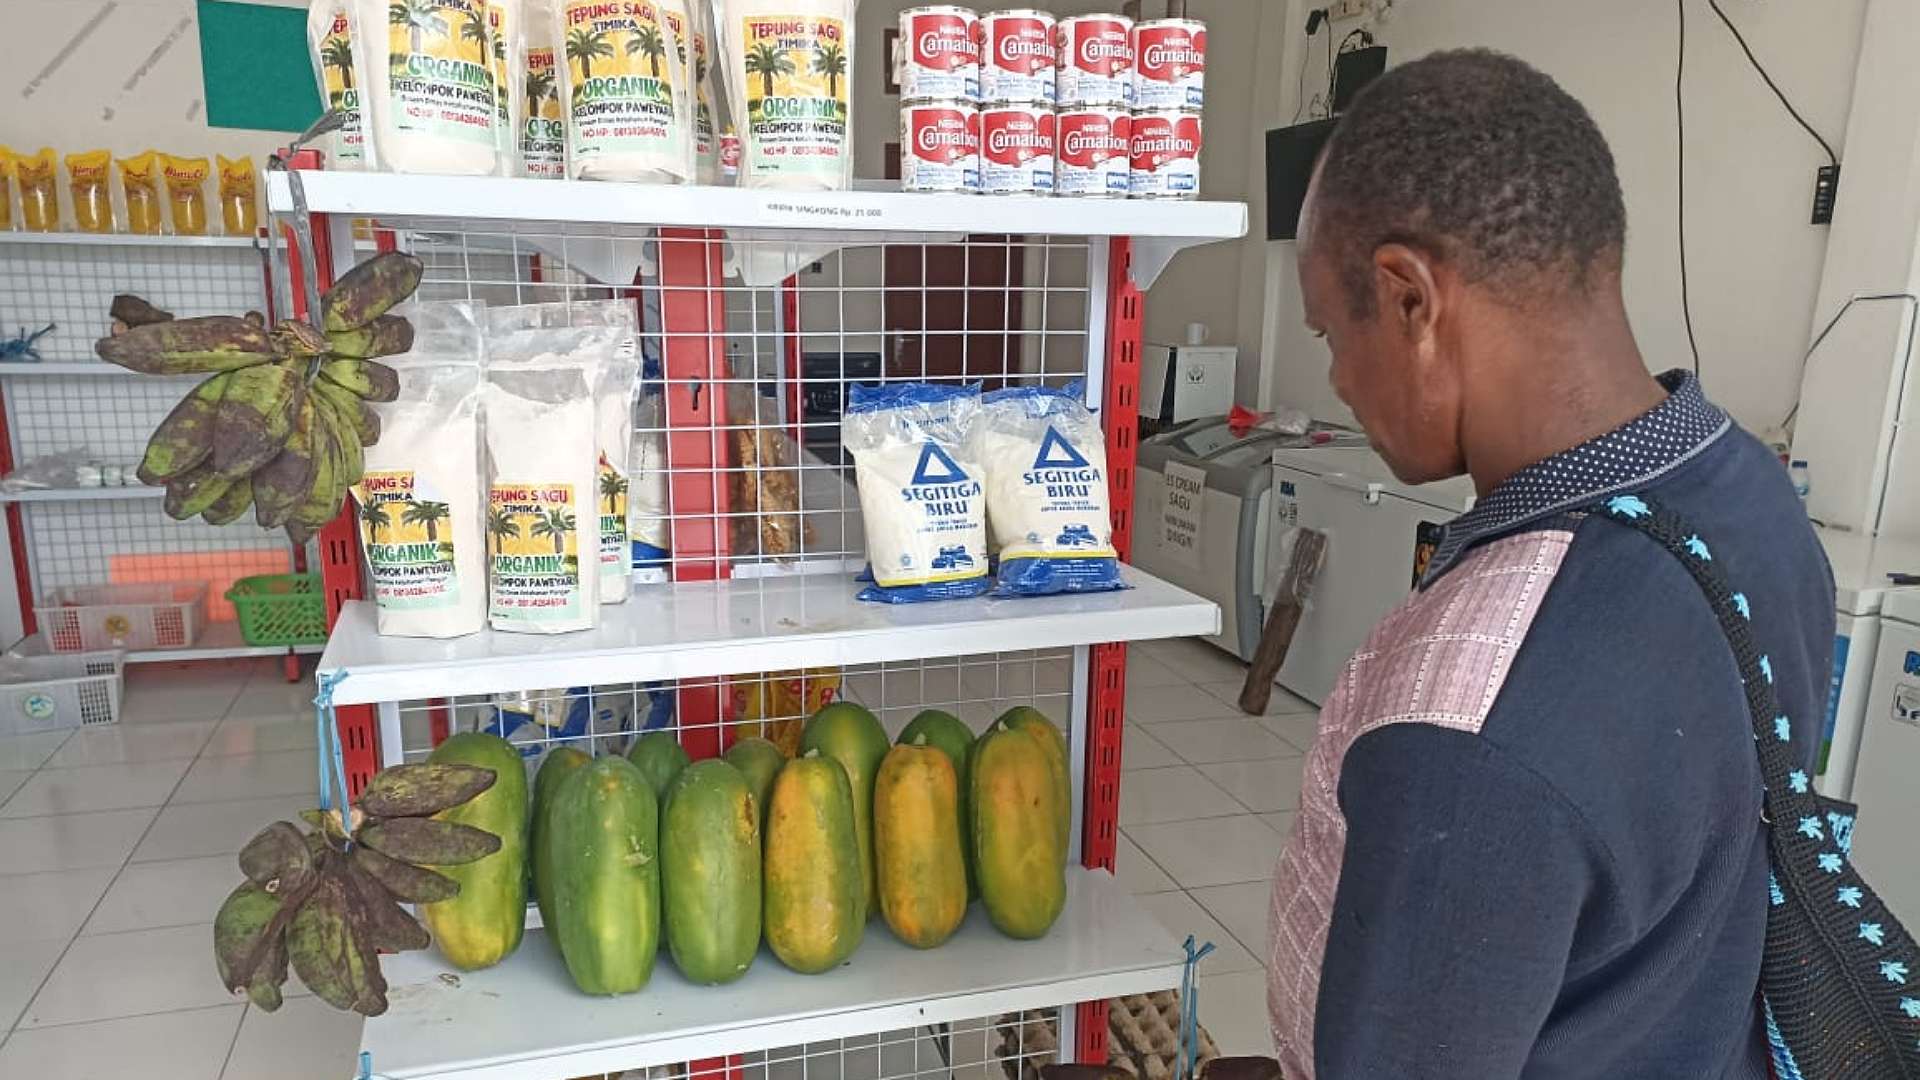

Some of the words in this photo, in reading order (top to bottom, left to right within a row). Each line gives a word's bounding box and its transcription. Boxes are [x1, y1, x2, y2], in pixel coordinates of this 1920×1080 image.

[567, 4, 619, 27] TEPUNG
[593, 19, 639, 32] TIMIKA
[750, 22, 805, 40] TEPUNG
[582, 76, 660, 98] ORGANIK
[763, 97, 836, 117] ORGANIK
[1023, 468, 1101, 486] SEGITIGA
[373, 493, 412, 501] TIMIKA
[531, 489, 567, 503] SAGU
[901, 482, 981, 501] SEGITIGA
[1047, 484, 1089, 498] BIRU
[924, 501, 968, 516] BIRU
